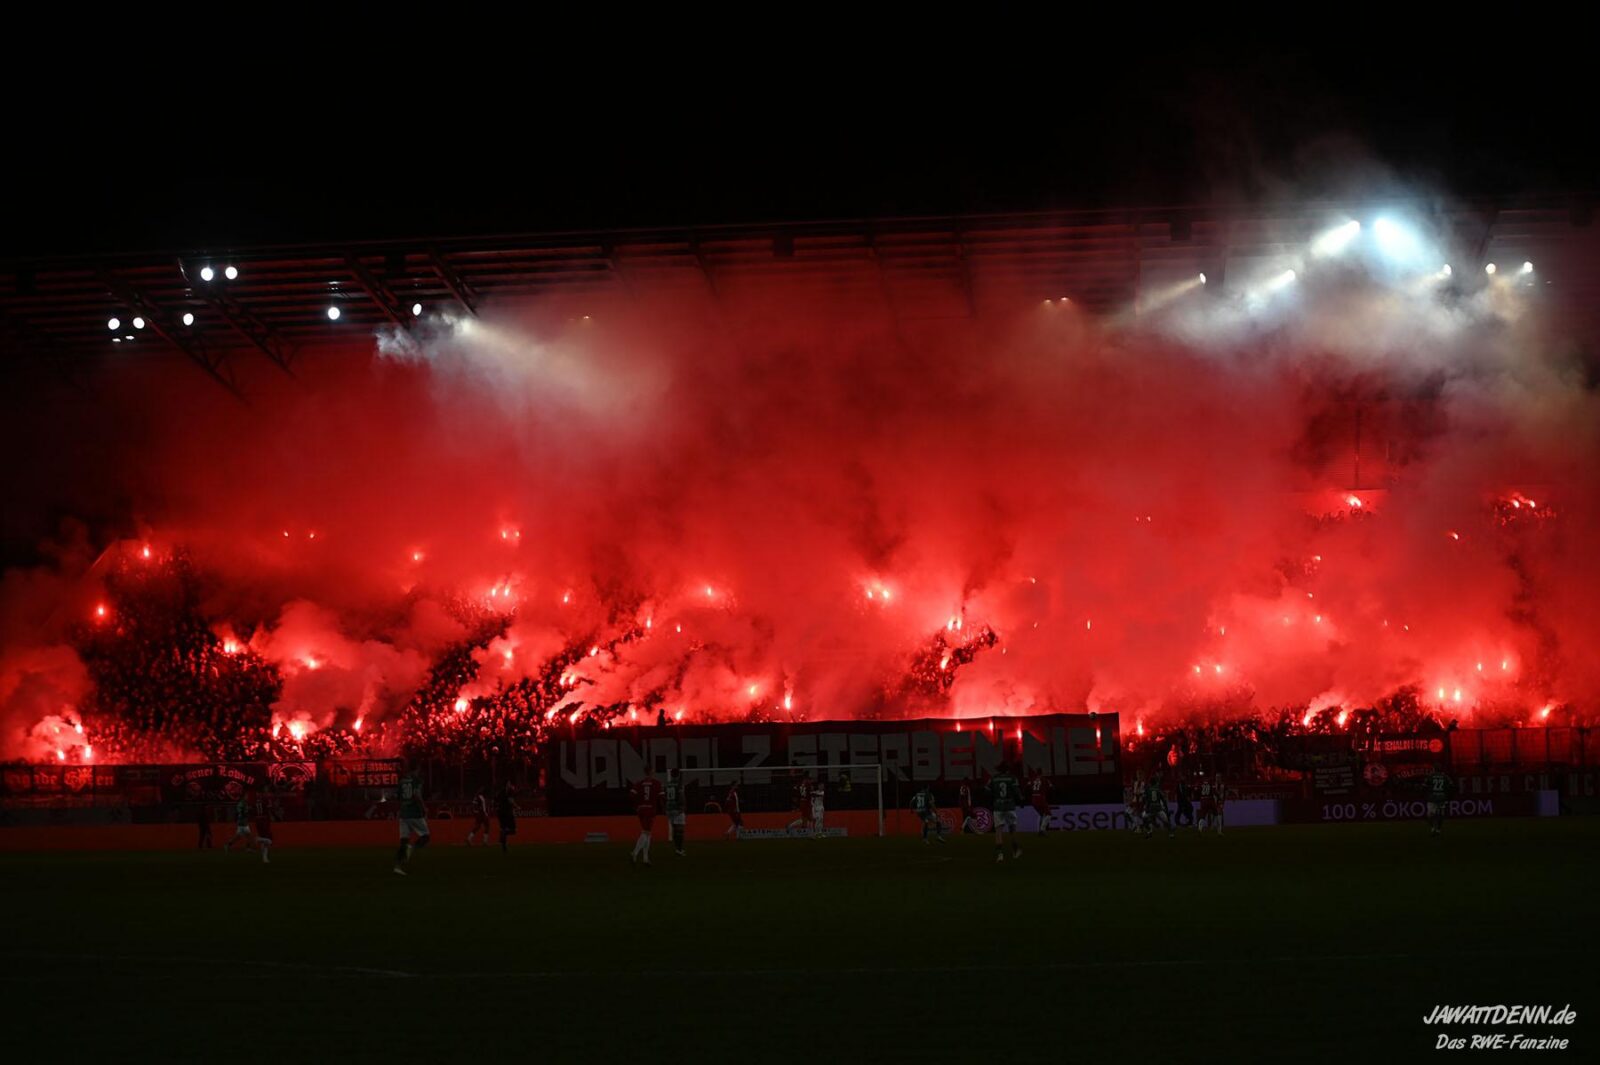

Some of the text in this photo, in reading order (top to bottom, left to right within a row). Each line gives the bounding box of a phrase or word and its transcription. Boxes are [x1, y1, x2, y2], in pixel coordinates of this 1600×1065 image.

[788, 727, 1004, 787] STERBEN
[1021, 724, 1117, 778] NIE!
[999, 782, 1007, 798] 3
[1321, 798, 1494, 820] 100 % ÖKOTROM
